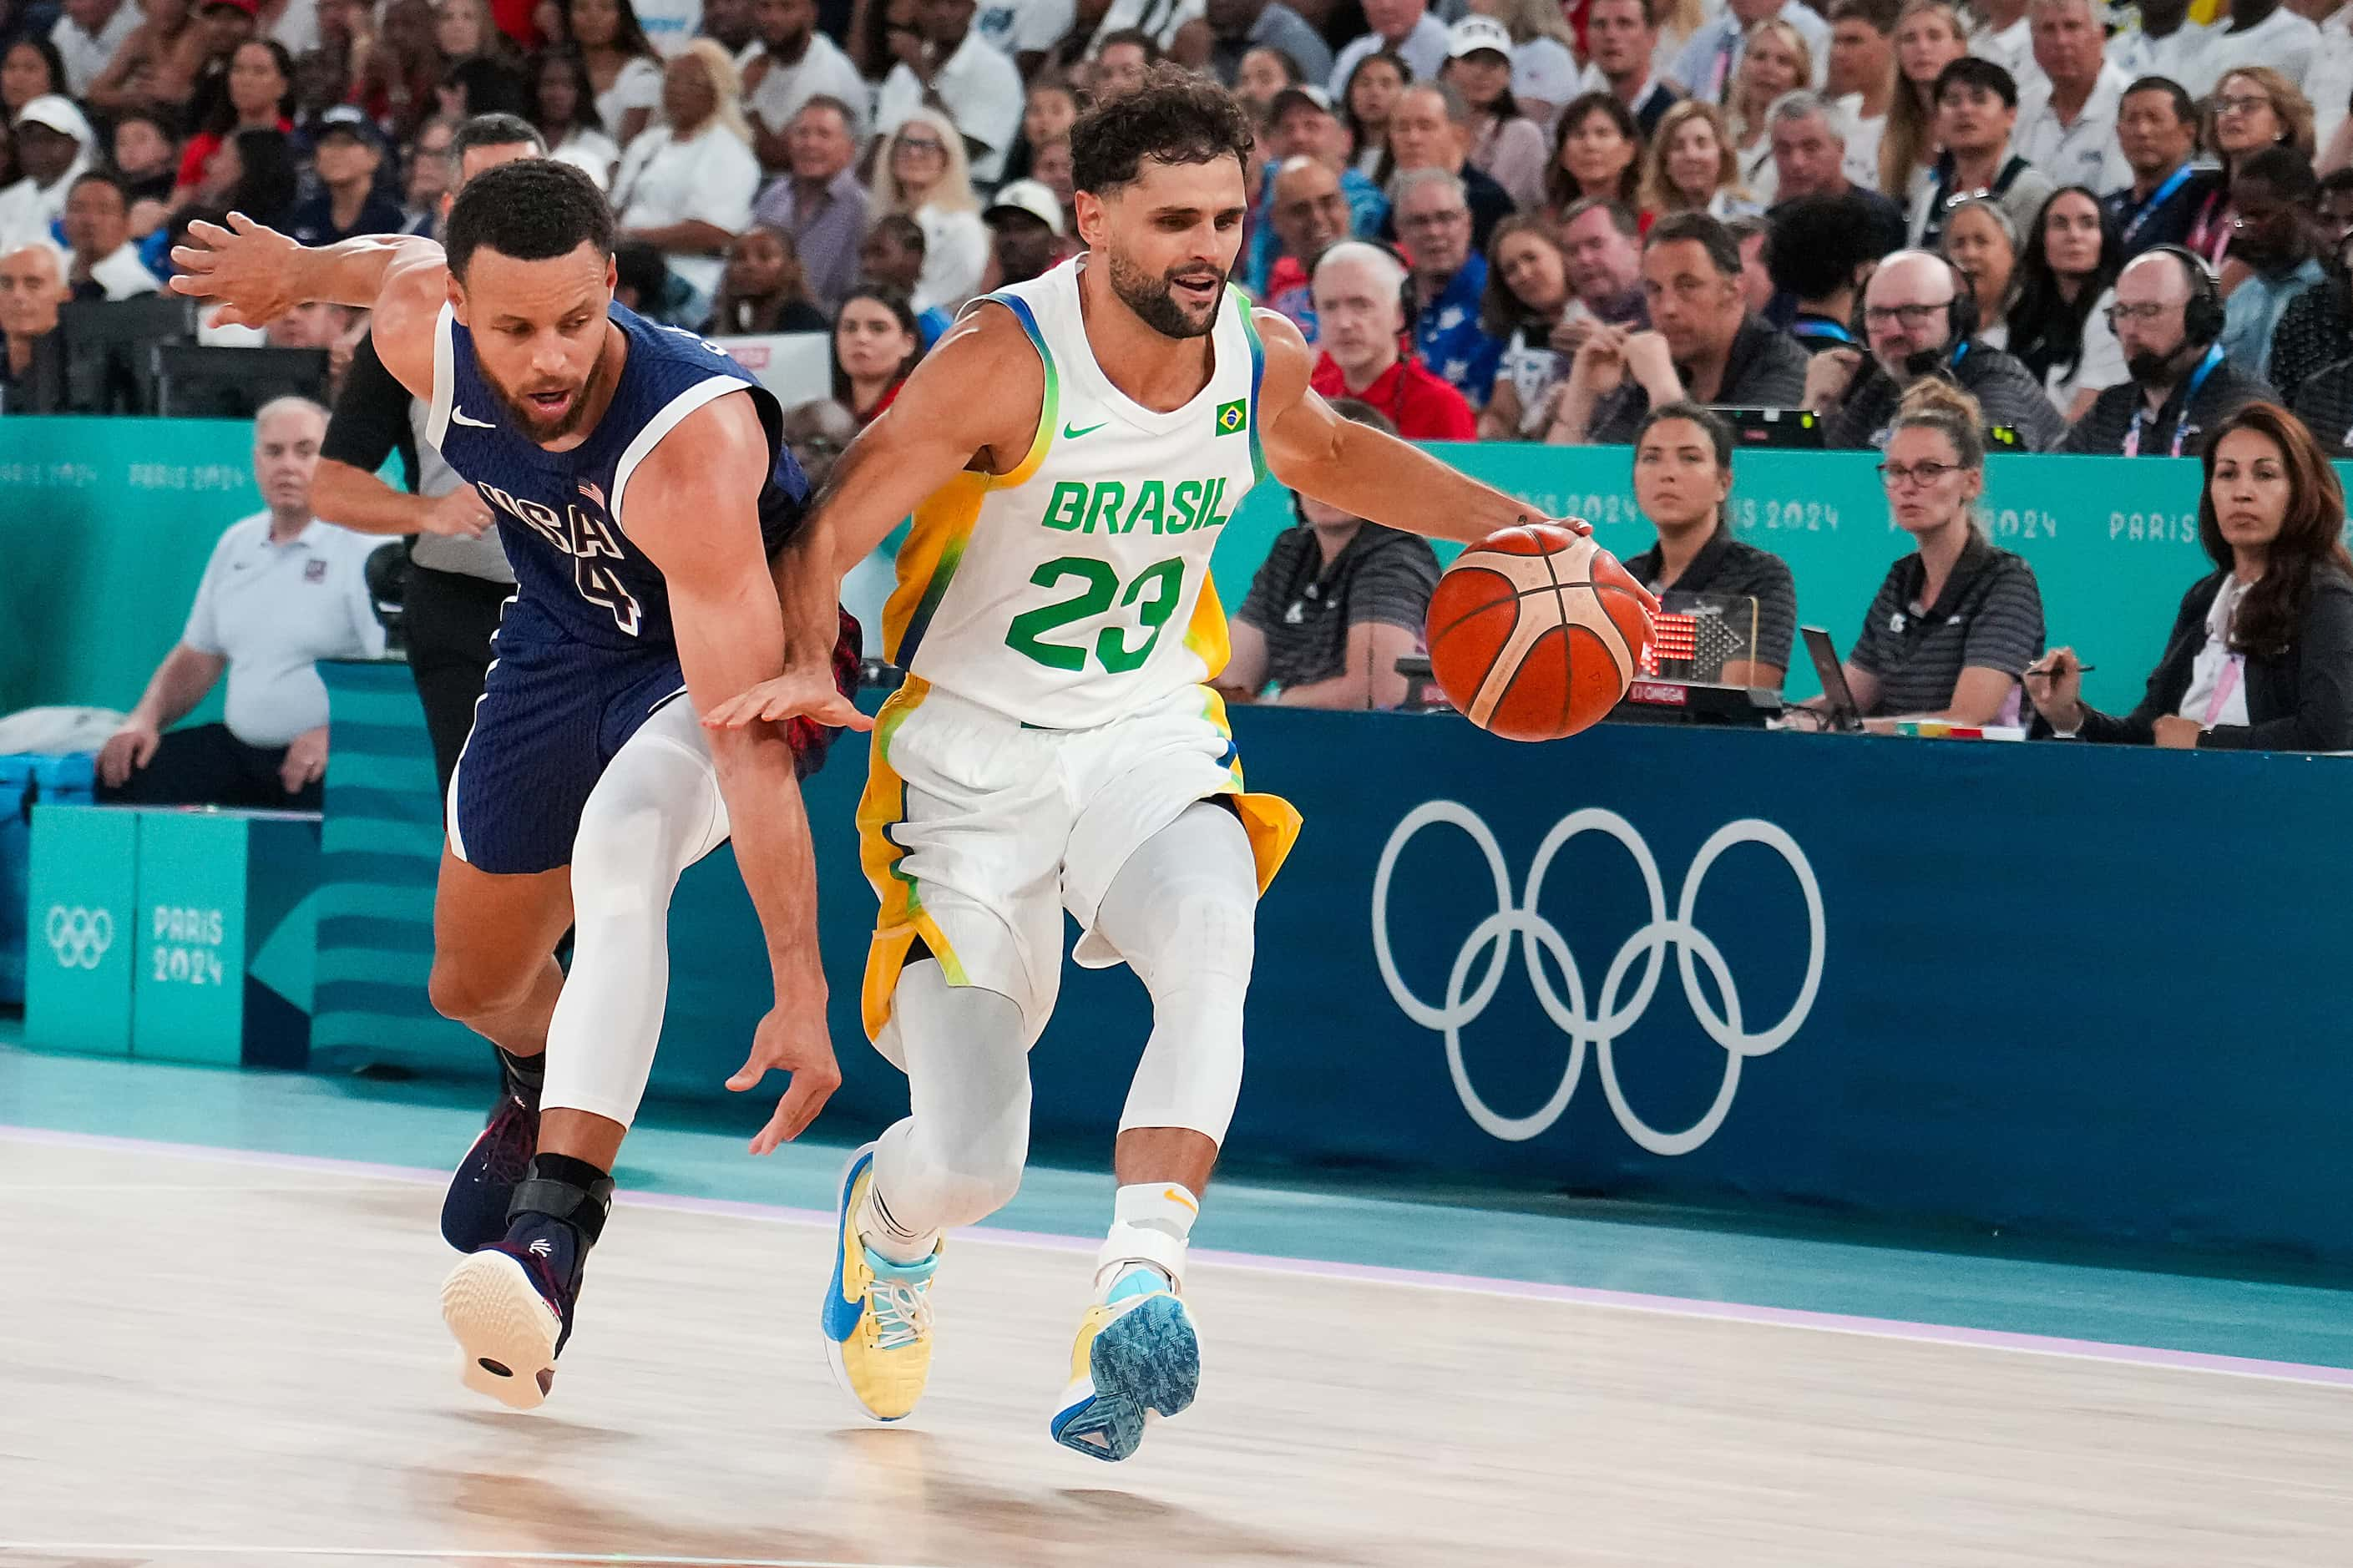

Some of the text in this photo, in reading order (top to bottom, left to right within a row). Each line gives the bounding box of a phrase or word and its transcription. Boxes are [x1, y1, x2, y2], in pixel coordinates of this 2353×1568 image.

[478, 481, 625, 559] USA
[1041, 478, 1228, 534] BRASIL
[1566, 493, 1637, 524] 2024
[1766, 500, 1839, 532] 2024
[2109, 510, 2195, 543] PARIS
[575, 555, 642, 637] 4
[1004, 556, 1186, 674] 23
[154, 906, 223, 945] PARIS
[154, 947, 223, 985] 2024
